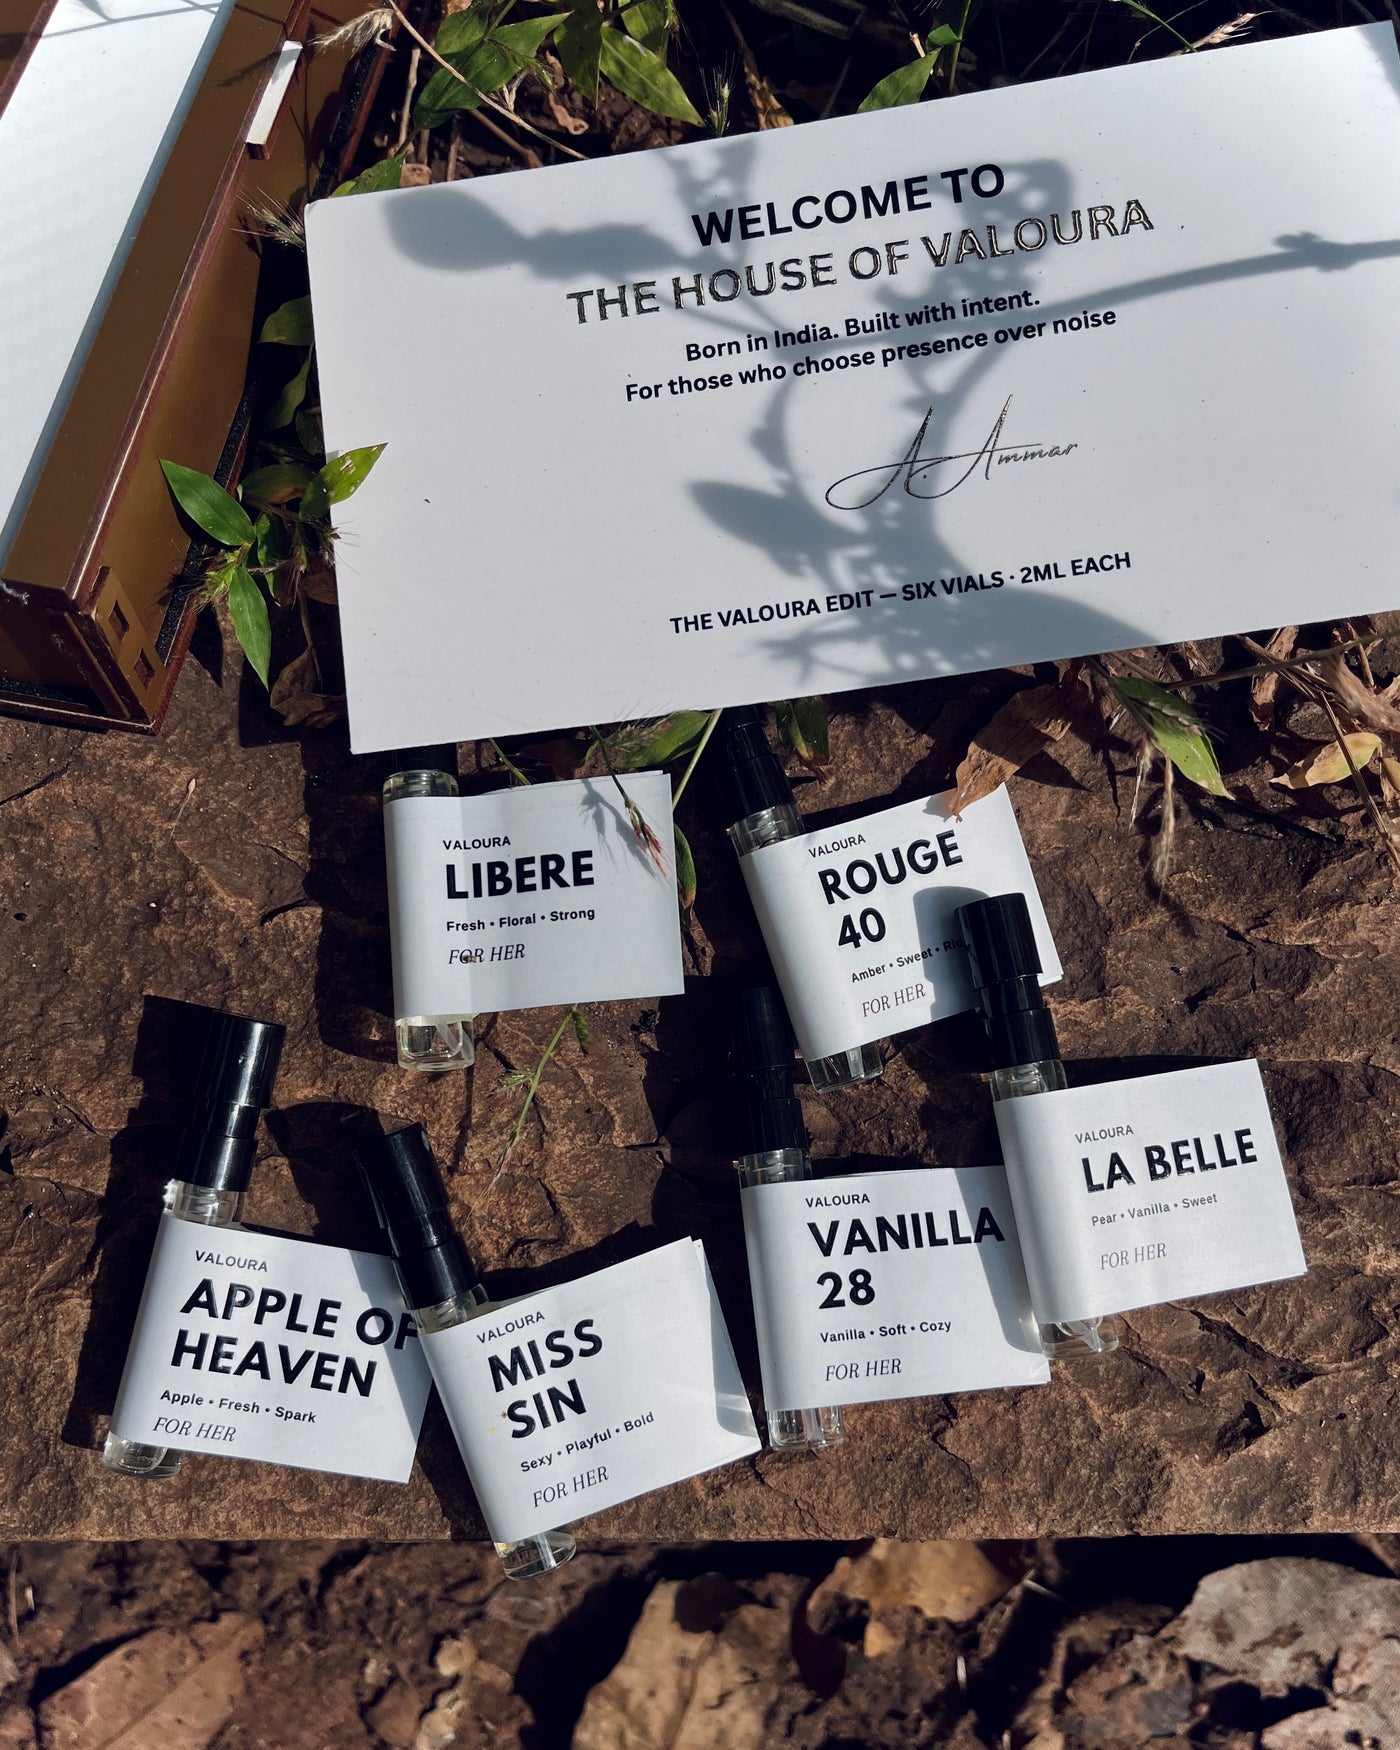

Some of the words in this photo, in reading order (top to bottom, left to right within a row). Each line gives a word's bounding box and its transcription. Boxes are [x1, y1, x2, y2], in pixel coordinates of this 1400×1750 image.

[692, 175, 932, 247] WELCOME
[941, 163, 1005, 202] TO
[566, 280, 660, 324] THE
[672, 253, 838, 311] HOUSE
[848, 240, 910, 280] OF
[921, 199, 1154, 268] VALOURA
[685, 335, 741, 362] Born
[746, 332, 768, 353] in
[774, 323, 839, 350] India.
[845, 312, 900, 337] Built
[904, 303, 956, 328] with
[961, 290, 1040, 318] intent.
[625, 380, 663, 402] For
[668, 370, 733, 396] those
[738, 362, 787, 386] who
[792, 349, 875, 378] choose
[881, 330, 988, 369] presence
[993, 322, 1047, 346] over
[1052, 308, 1116, 335] noise
[670, 613, 713, 634] THE
[718, 598, 820, 628] VALOURA
[825, 590, 874, 613] EDIT
[901, 580, 936, 603] SIX
[940, 571, 1004, 596] VIALS
[1020, 562, 1065, 585] 2ML
[1070, 552, 1132, 577] EACH
[442, 834, 511, 850] VALOURA
[808, 833, 866, 858] VALOURA
[445, 849, 595, 901] LIBERE
[817, 829, 964, 904] ROUGE
[445, 917, 486, 932] Fresh
[498, 911, 537, 928] Floral
[550, 906, 596, 924] Strong
[836, 906, 886, 950] 40
[448, 947, 484, 965] FOR
[489, 942, 526, 962] HER
[850, 962, 887, 983] Amber
[895, 946, 934, 968] Sweet
[861, 993, 890, 1018] FOR
[893, 982, 927, 1008] HER
[1075, 1124, 1134, 1144] VALOURA
[1081, 1151, 1136, 1194] LA
[1146, 1127, 1258, 1182] BELLE
[805, 1193, 870, 1209] VALOURA
[1091, 1212, 1118, 1227] Pear
[1127, 1201, 1171, 1219] Vanilla
[1182, 1193, 1218, 1210] Sweet
[807, 1206, 1006, 1258] VANILLA
[195, 1249, 269, 1273] VALOURA
[1100, 1248, 1131, 1270] FOR
[1134, 1242, 1168, 1263] HER
[817, 1268, 876, 1309] 28
[180, 1277, 342, 1339] APPLE
[356, 1307, 418, 1350] OF
[476, 1310, 545, 1345] VALOURA
[820, 1326, 866, 1344] Vanilla
[878, 1323, 908, 1337] Soft
[919, 1320, 952, 1336] Cozy
[170, 1329, 377, 1399] HEAVEN
[487, 1318, 604, 1394] MISS
[824, 1364, 861, 1383] FOR
[865, 1358, 902, 1377] HER
[160, 1388, 204, 1407] Apple
[218, 1397, 261, 1415] Fresh
[274, 1405, 317, 1424] Spark
[507, 1379, 587, 1439] SIN
[152, 1415, 192, 1437] FOR
[195, 1421, 237, 1443] HER
[520, 1453, 554, 1474] Sexy
[565, 1428, 612, 1456] Playful
[623, 1411, 655, 1432] Bold
[531, 1483, 570, 1508] FOR
[571, 1465, 610, 1492] HER
